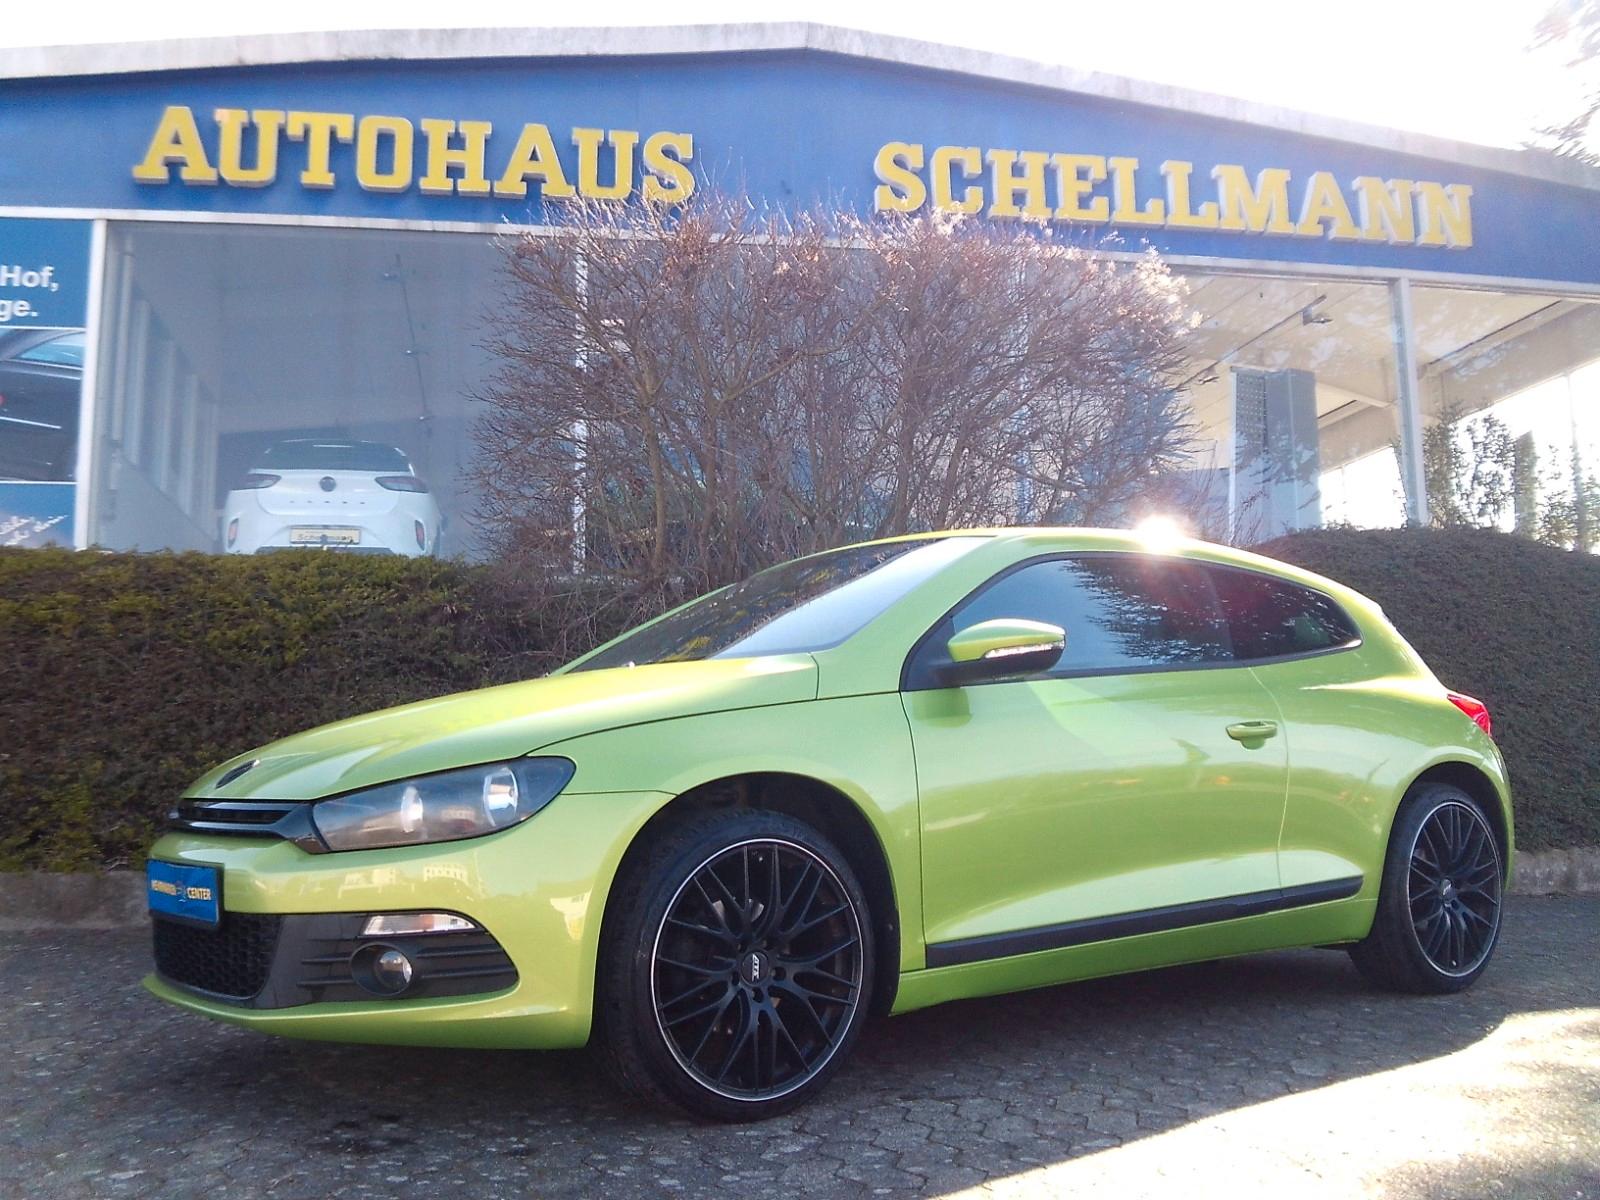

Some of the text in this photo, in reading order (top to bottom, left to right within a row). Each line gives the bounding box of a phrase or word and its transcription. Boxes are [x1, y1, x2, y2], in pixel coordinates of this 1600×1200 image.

[131, 105, 697, 204] AUTOHAUS
[873, 141, 1474, 250] SCHELLMANN
[0, 265, 59, 292] Hof,
[186, 887, 212, 901] CENTER
